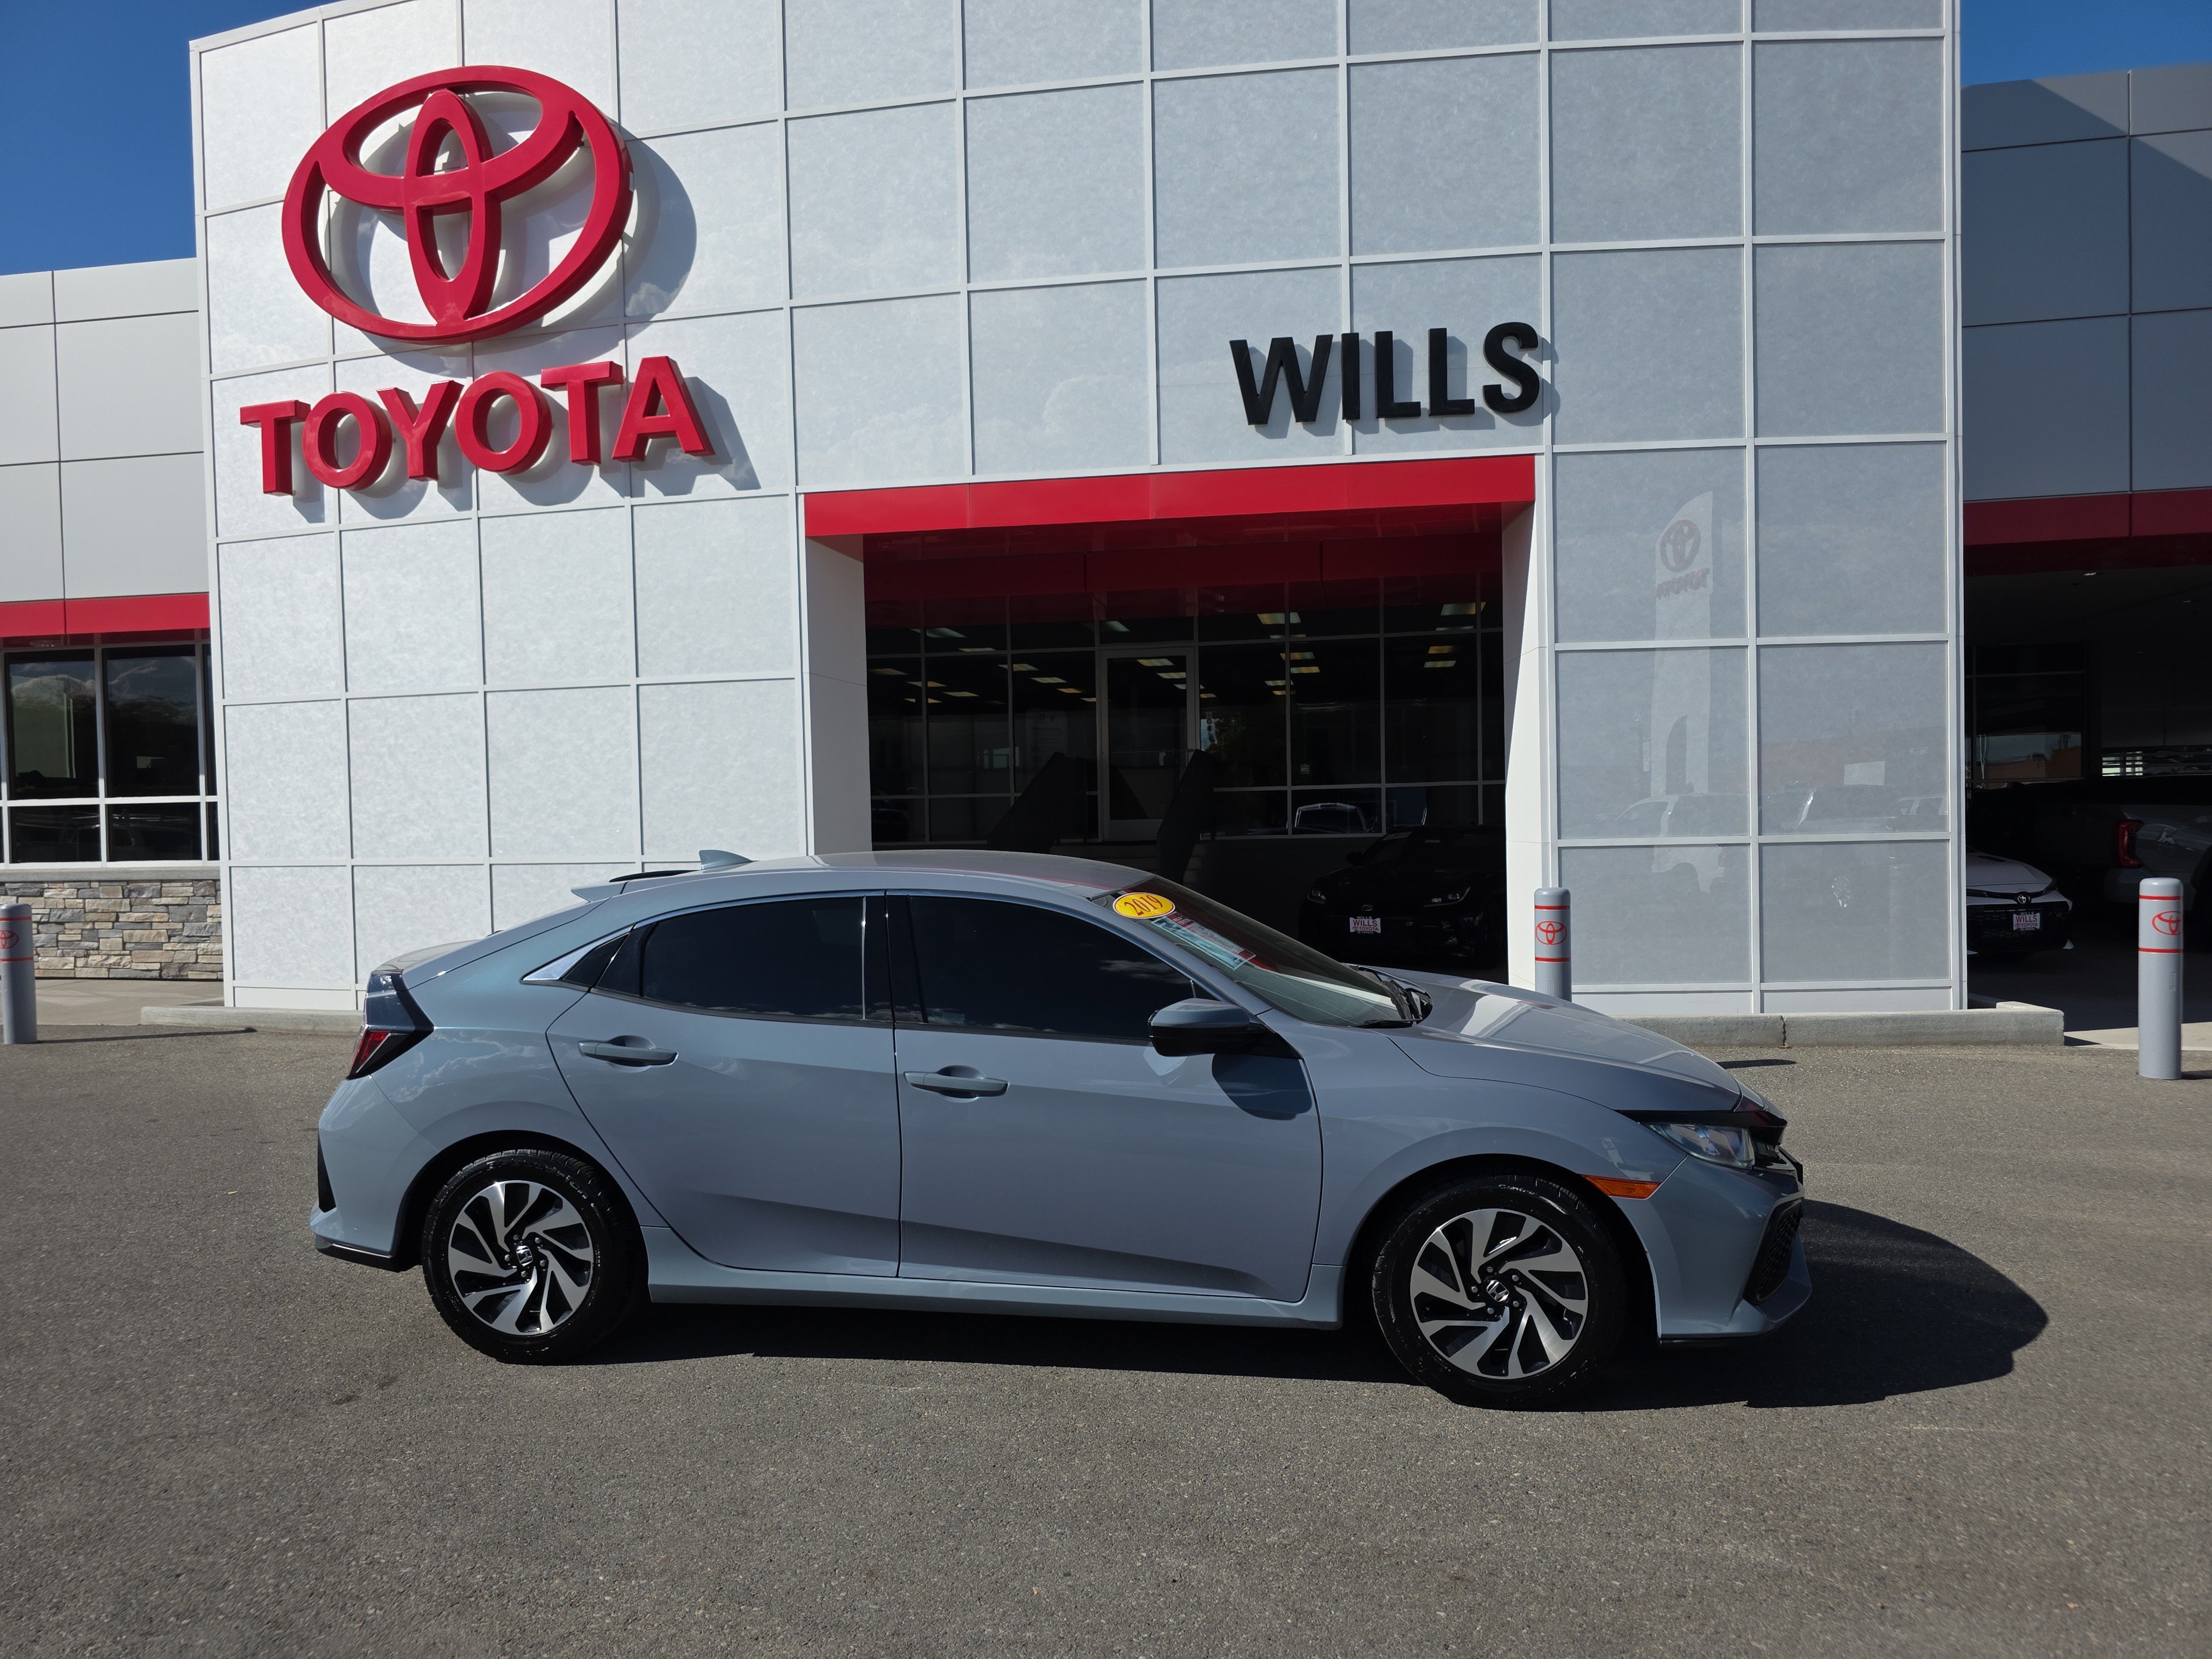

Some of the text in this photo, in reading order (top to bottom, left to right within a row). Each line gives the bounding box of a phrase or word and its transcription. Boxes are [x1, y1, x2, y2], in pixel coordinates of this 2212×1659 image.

[1230, 321, 1540, 425] WILLS
[240, 356, 715, 496] TOYOTA
[1124, 895, 1163, 916] 2019
